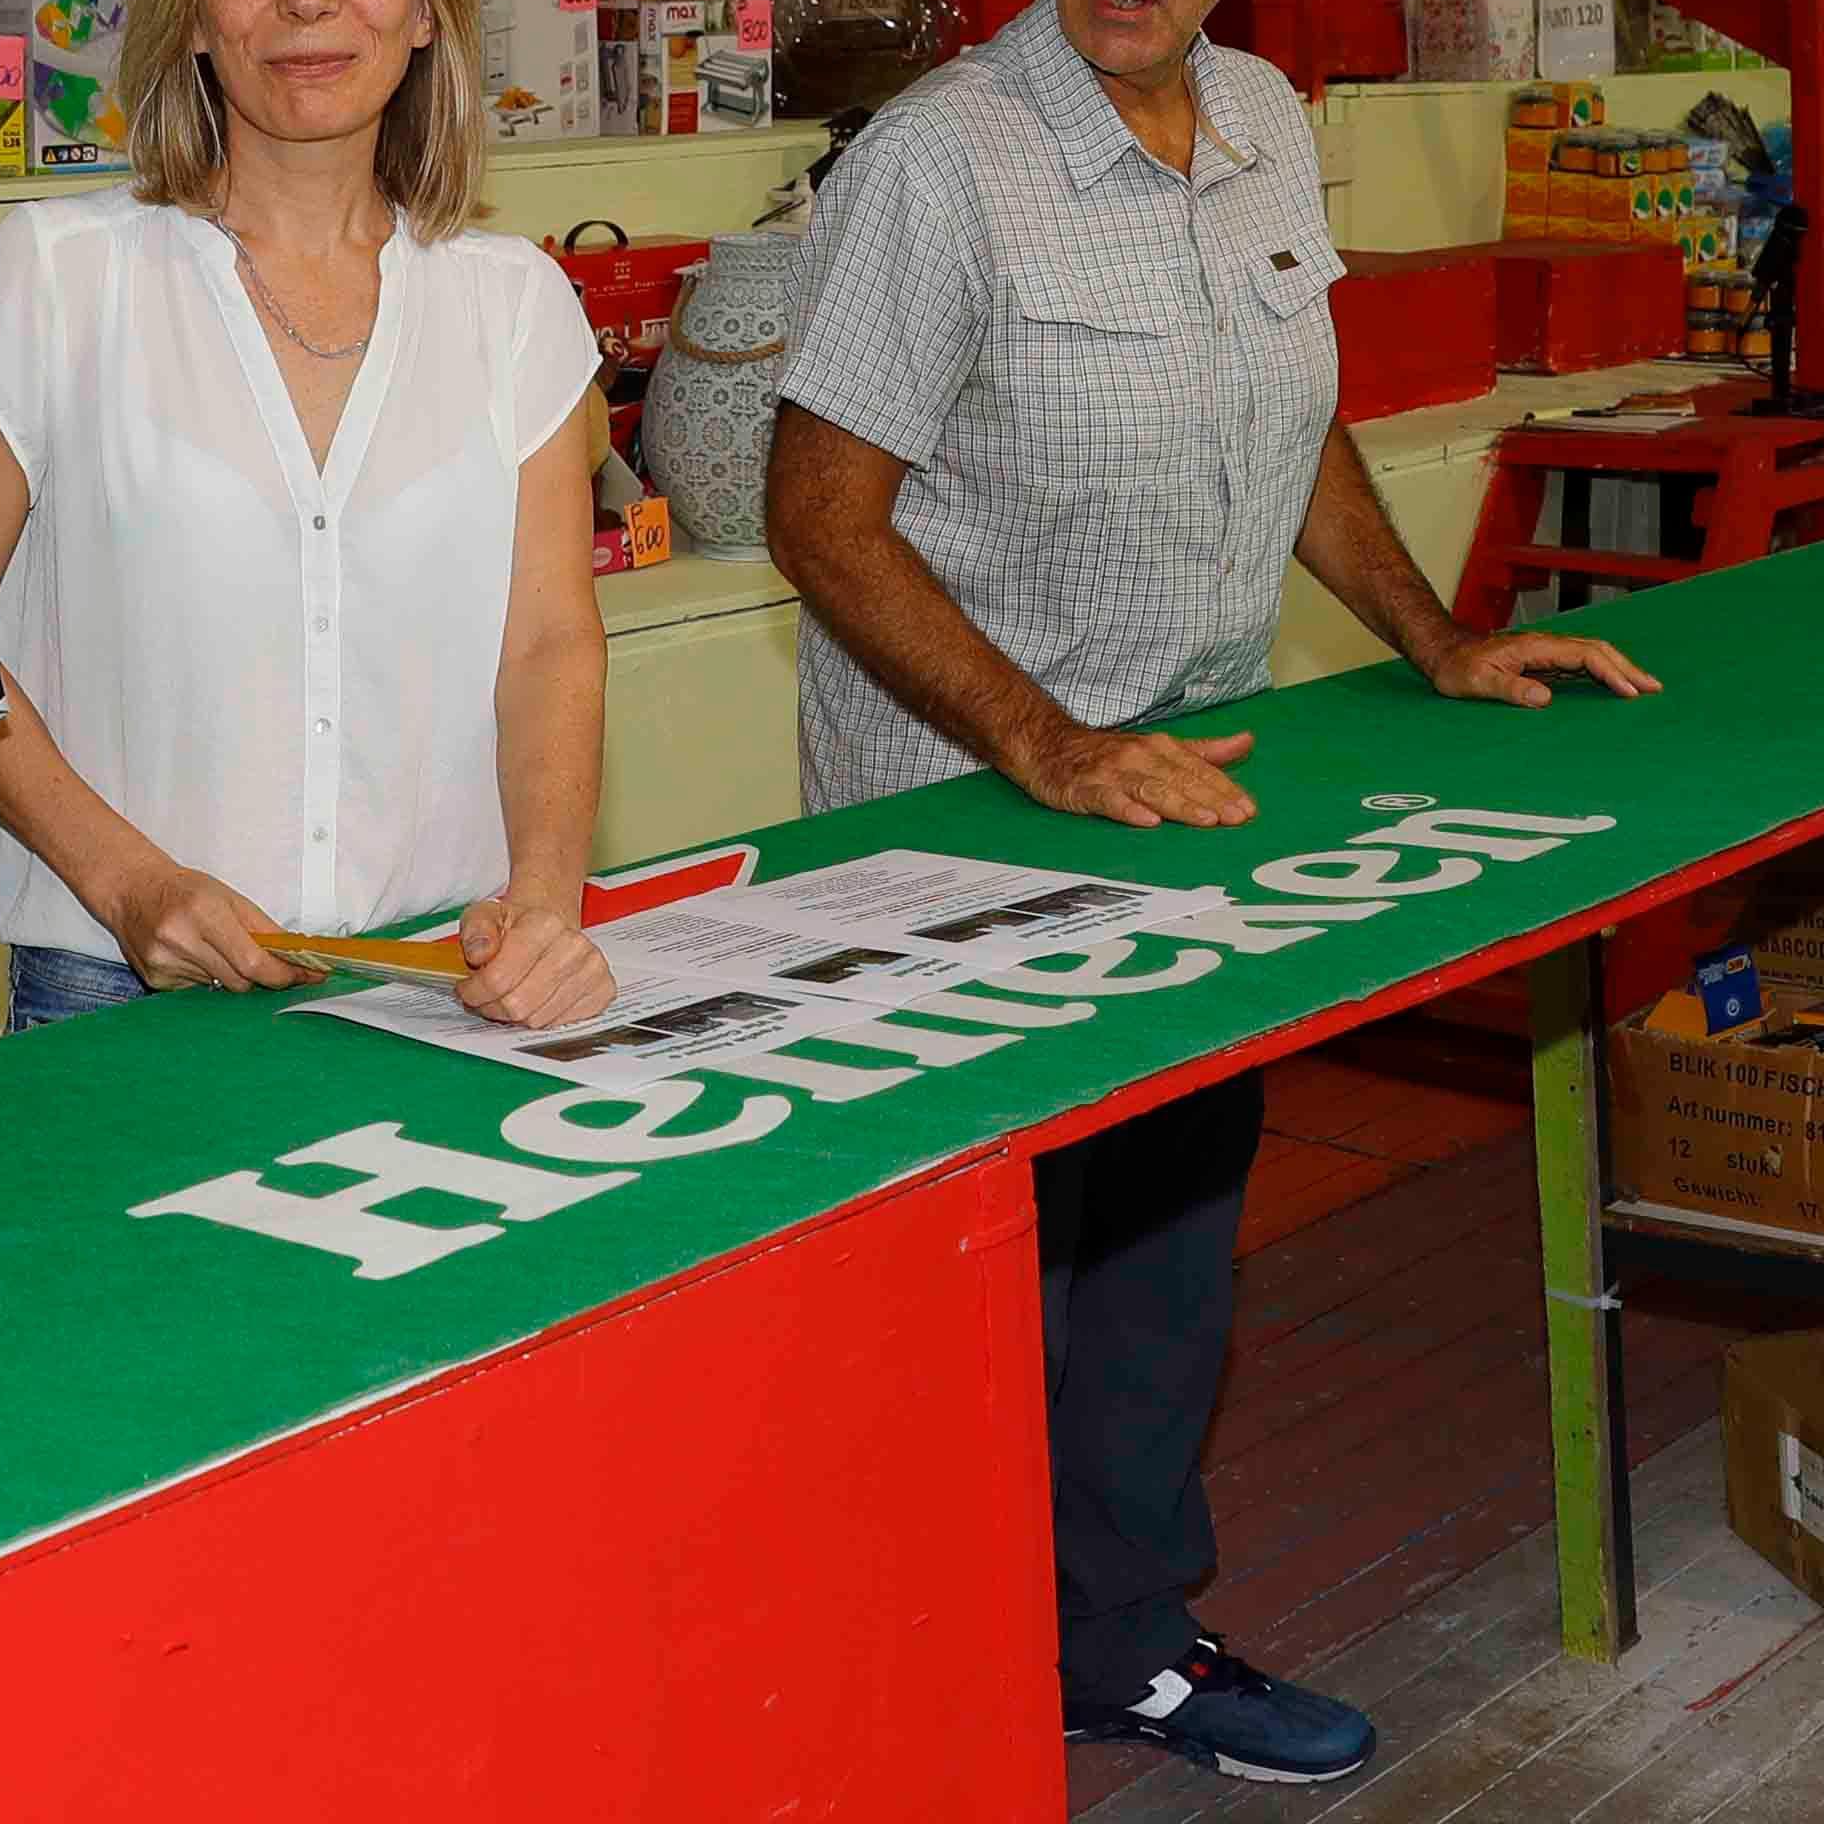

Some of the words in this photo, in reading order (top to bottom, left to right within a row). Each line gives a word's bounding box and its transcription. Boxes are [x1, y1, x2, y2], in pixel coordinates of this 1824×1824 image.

[665, 5, 697, 21] max
[1576, 4, 1604, 25] 120
[634, 525, 665, 555] 600
[1669, 1052, 1715, 1077] BLIK
[1724, 1061, 1758, 1087] 100
[1668, 1095, 1700, 1119] Art
[1704, 1103, 1793, 1136] nummer:
[1667, 1138, 1692, 1160] 12
